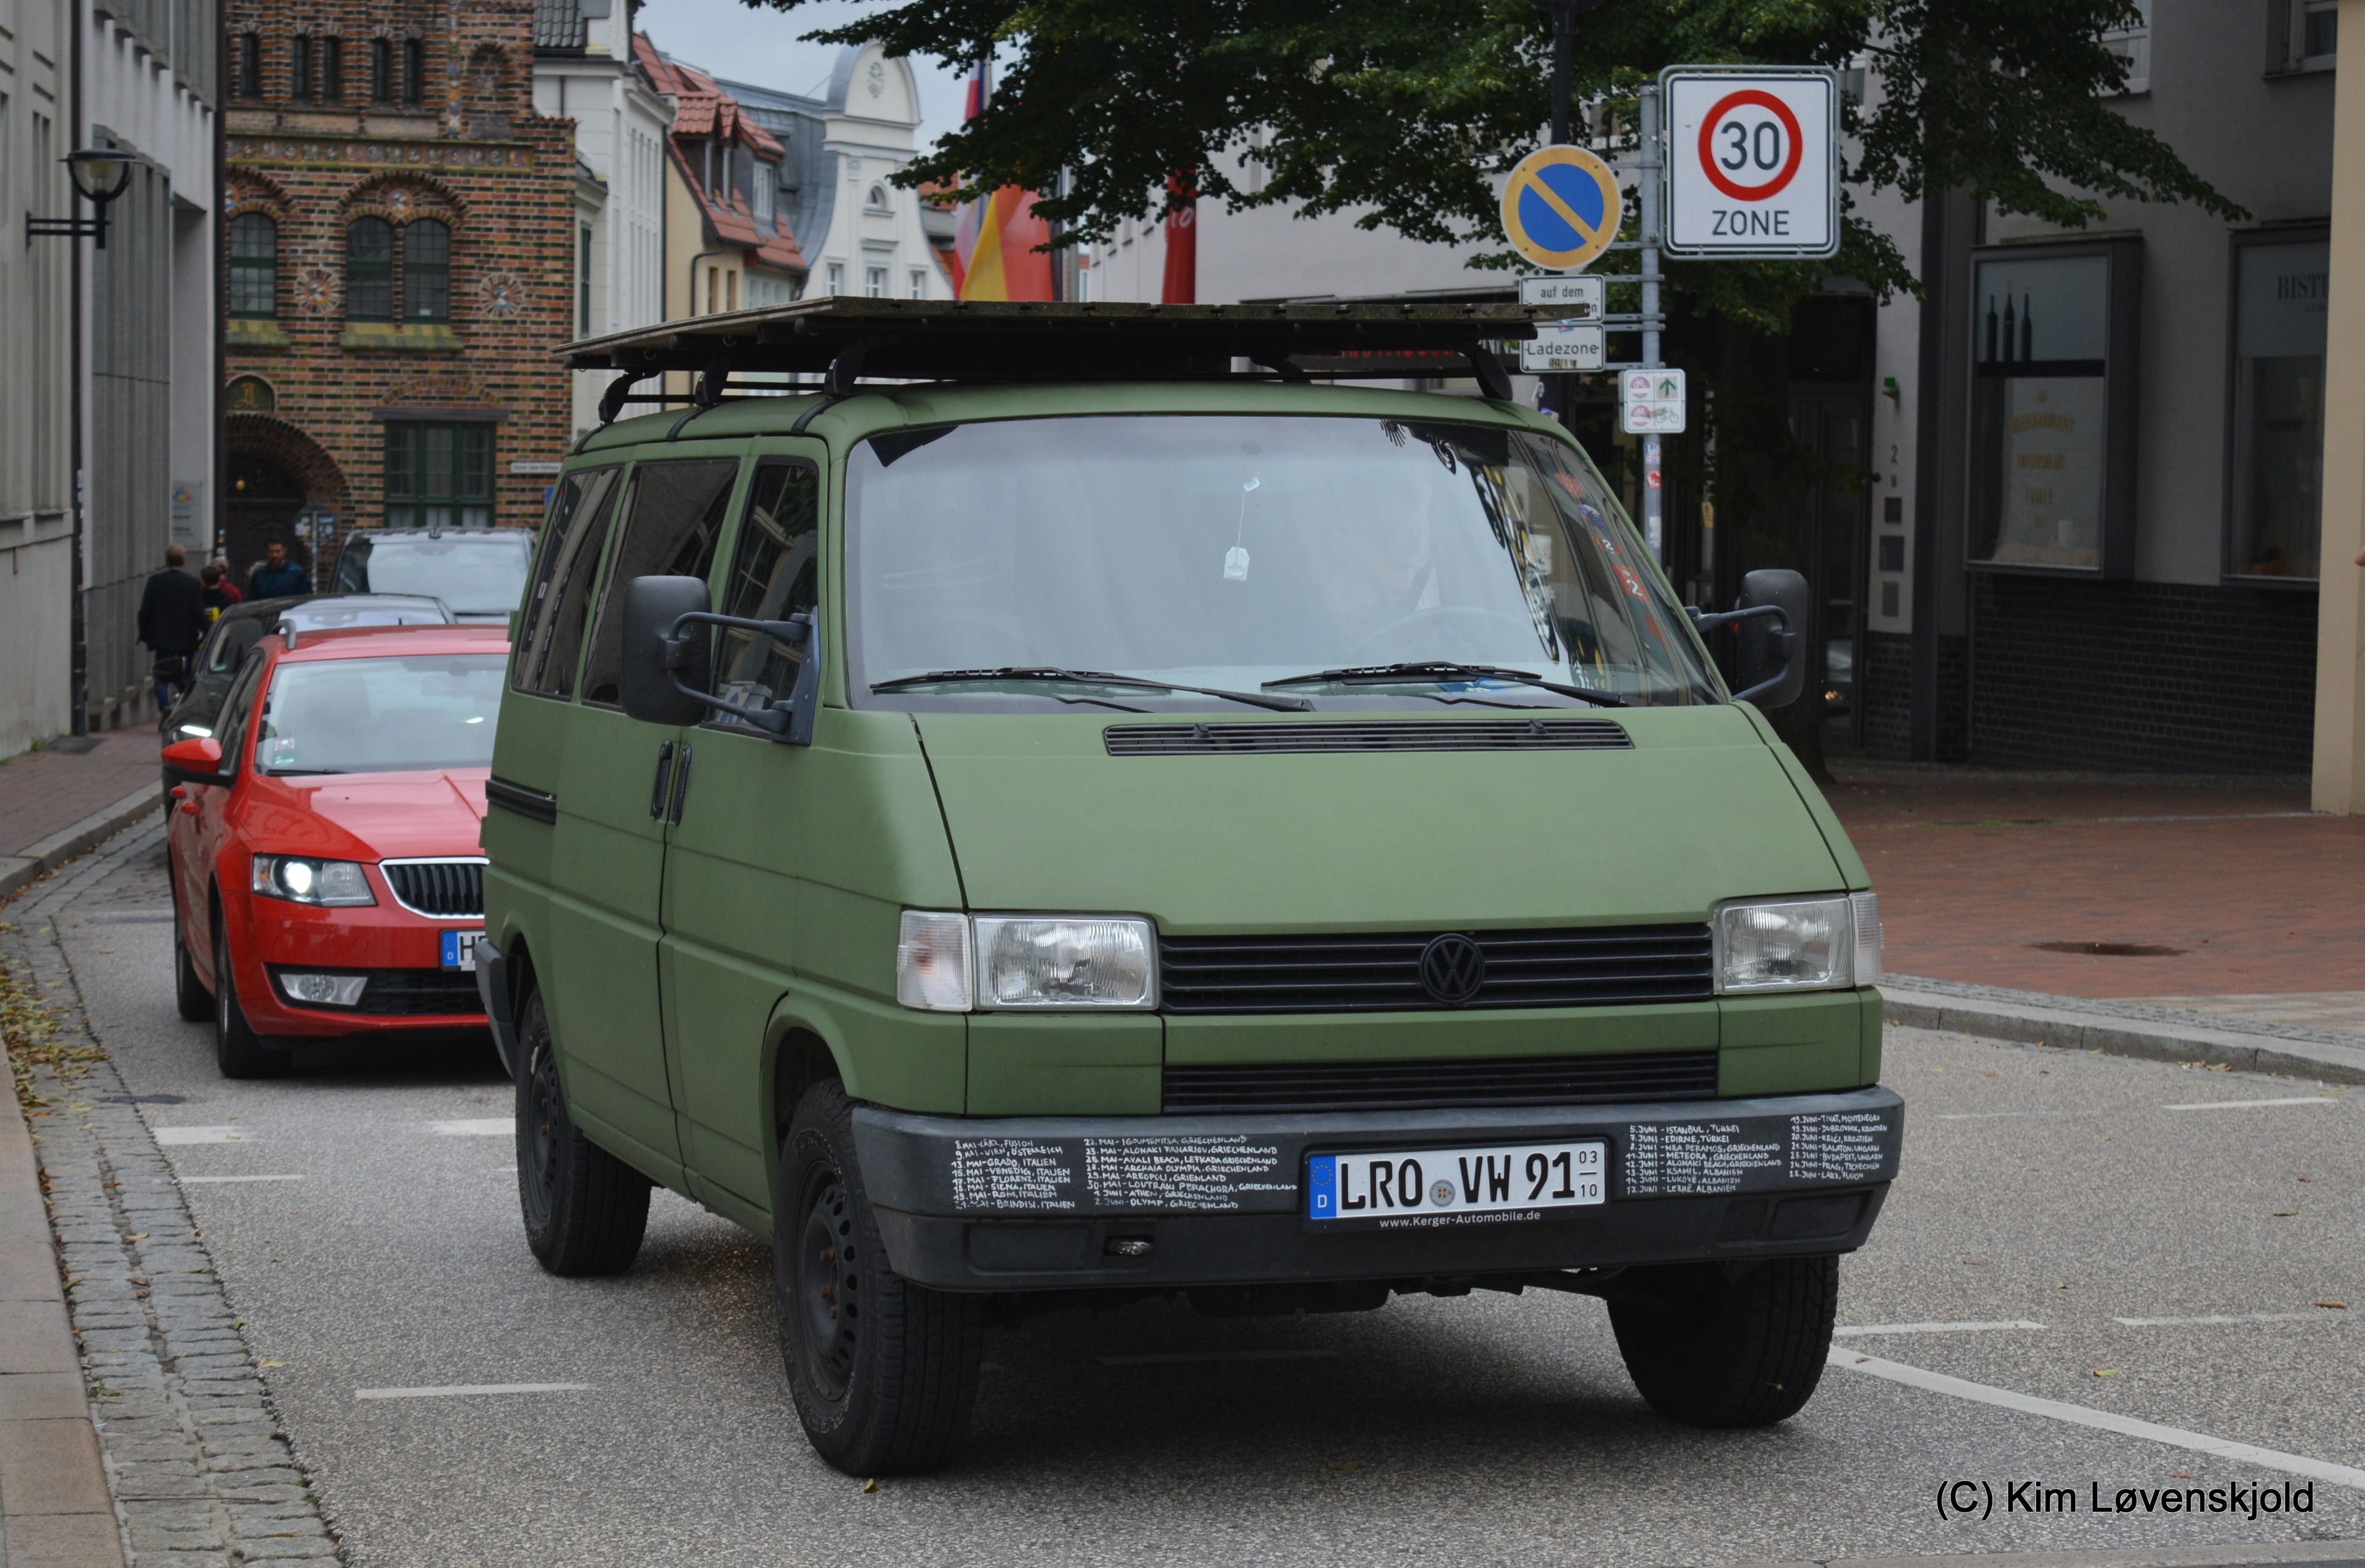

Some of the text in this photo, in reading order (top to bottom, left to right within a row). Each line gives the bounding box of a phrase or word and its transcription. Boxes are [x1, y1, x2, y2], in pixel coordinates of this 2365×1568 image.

[1721, 121, 1780, 171] 30
[1712, 211, 1790, 236] ZONE
[1540, 286, 1583, 297] auf dem
[2278, 273, 2326, 301] BIST
[1527, 342, 1597, 355] Ladezone
[1579, 1150, 1597, 1163] 03
[1341, 1152, 1575, 1210] LRO VW 91
[1580, 1184, 1597, 1197] 10
[1317, 1195, 1327, 1208] D
[1379, 1211, 1540, 1229] www.Kerger-Automobile.de
